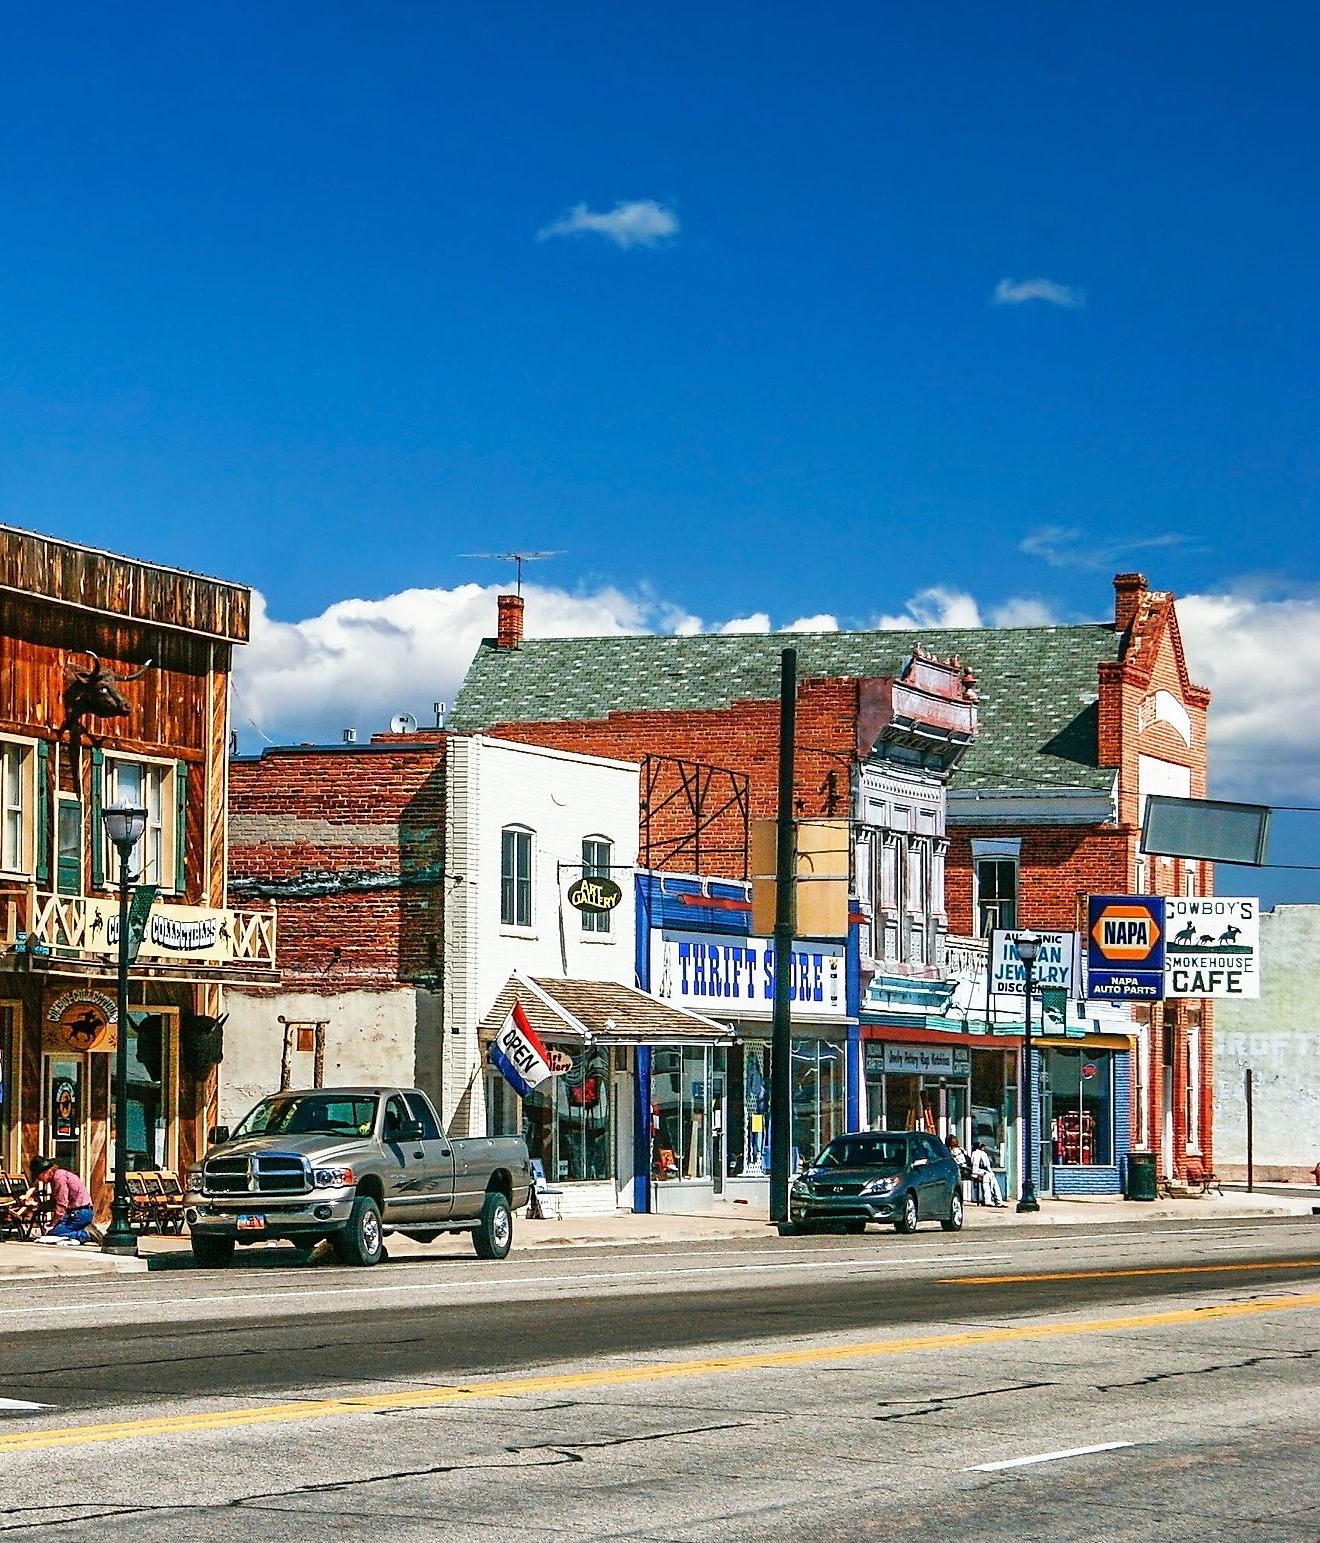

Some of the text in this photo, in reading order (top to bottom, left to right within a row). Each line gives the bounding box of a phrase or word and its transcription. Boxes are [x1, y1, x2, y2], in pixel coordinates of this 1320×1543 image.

[581, 879, 603, 895] ART
[571, 890, 617, 909] GALLERY
[151, 914, 217, 951] COLLECTIBLES
[1104, 921, 1148, 945] NAPA
[1003, 944, 1061, 963] INAN
[679, 942, 757, 999] THRIFT
[1093, 985, 1157, 995] AUTO PARTS
[1111, 977, 1138, 986] NAPA
[1173, 971, 1242, 993] CAFE
[502, 1029, 540, 1074] OPEN
